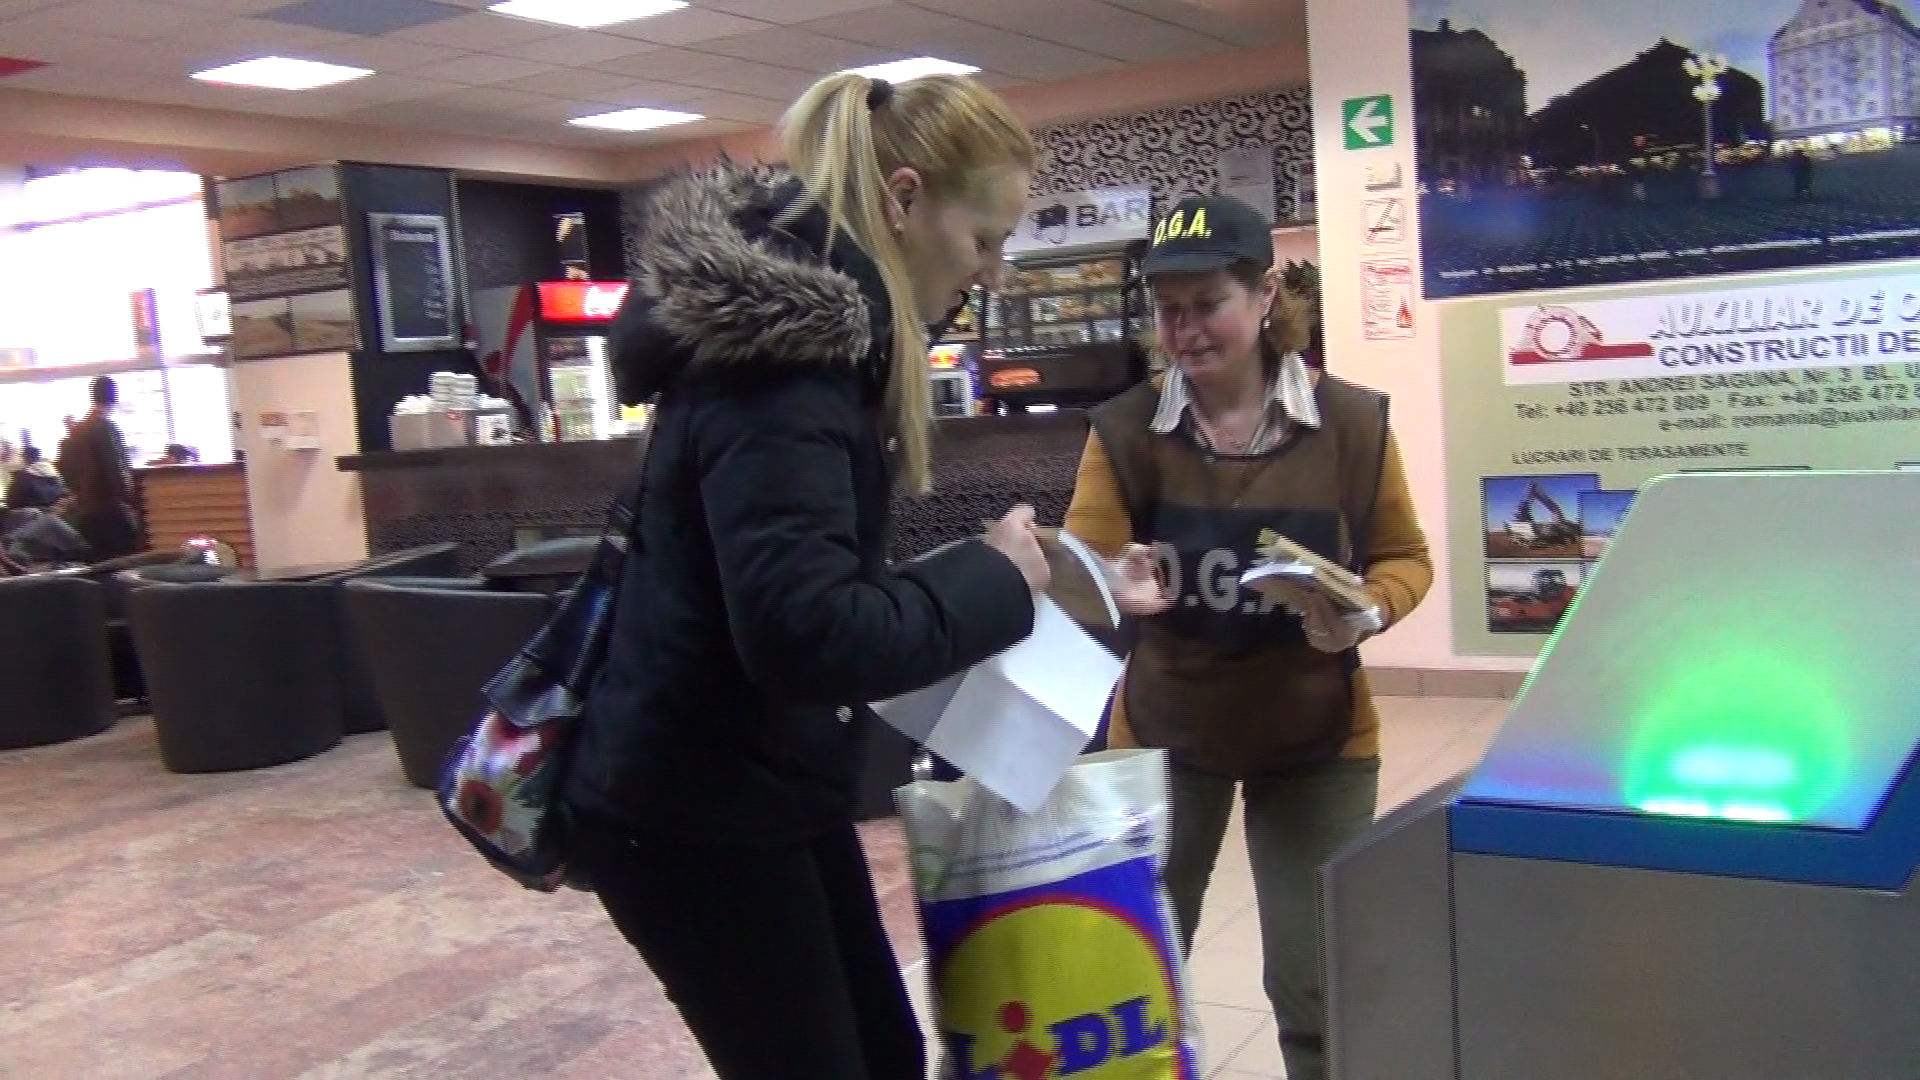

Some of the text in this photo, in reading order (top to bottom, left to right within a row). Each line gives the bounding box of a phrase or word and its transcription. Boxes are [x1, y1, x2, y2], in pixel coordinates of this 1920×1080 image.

[1076, 198, 1148, 228] BAR
[1649, 297, 1823, 339] AUXILIAR
[1831, 290, 1885, 326] DE
[1658, 329, 1920, 367] CONSTRUCTII DE
[1568, 382, 1614, 398] STR.
[1617, 376, 1695, 394] ANDREI
[1699, 371, 1798, 391] SAGUNA,
[1803, 369, 1832, 384] Nr.
[1838, 367, 1852, 382] 3
[1862, 364, 1900, 381] BL.
[1514, 403, 1549, 419] Tel:
[1554, 401, 1590, 417] +40
[1592, 399, 1629, 416] 256
[1632, 397, 1668, 413] 472
[1673, 394, 1711, 411] 809
[1728, 391, 1774, 408] Fax:
[1780, 388, 1820, 404] +40
[1822, 385, 1864, 402] 256
[1867, 383, 1909, 400] 472
[1658, 413, 1728, 431] e-mail:
[1512, 443, 1750, 465] LUCRARI DE TERASAMENTE
